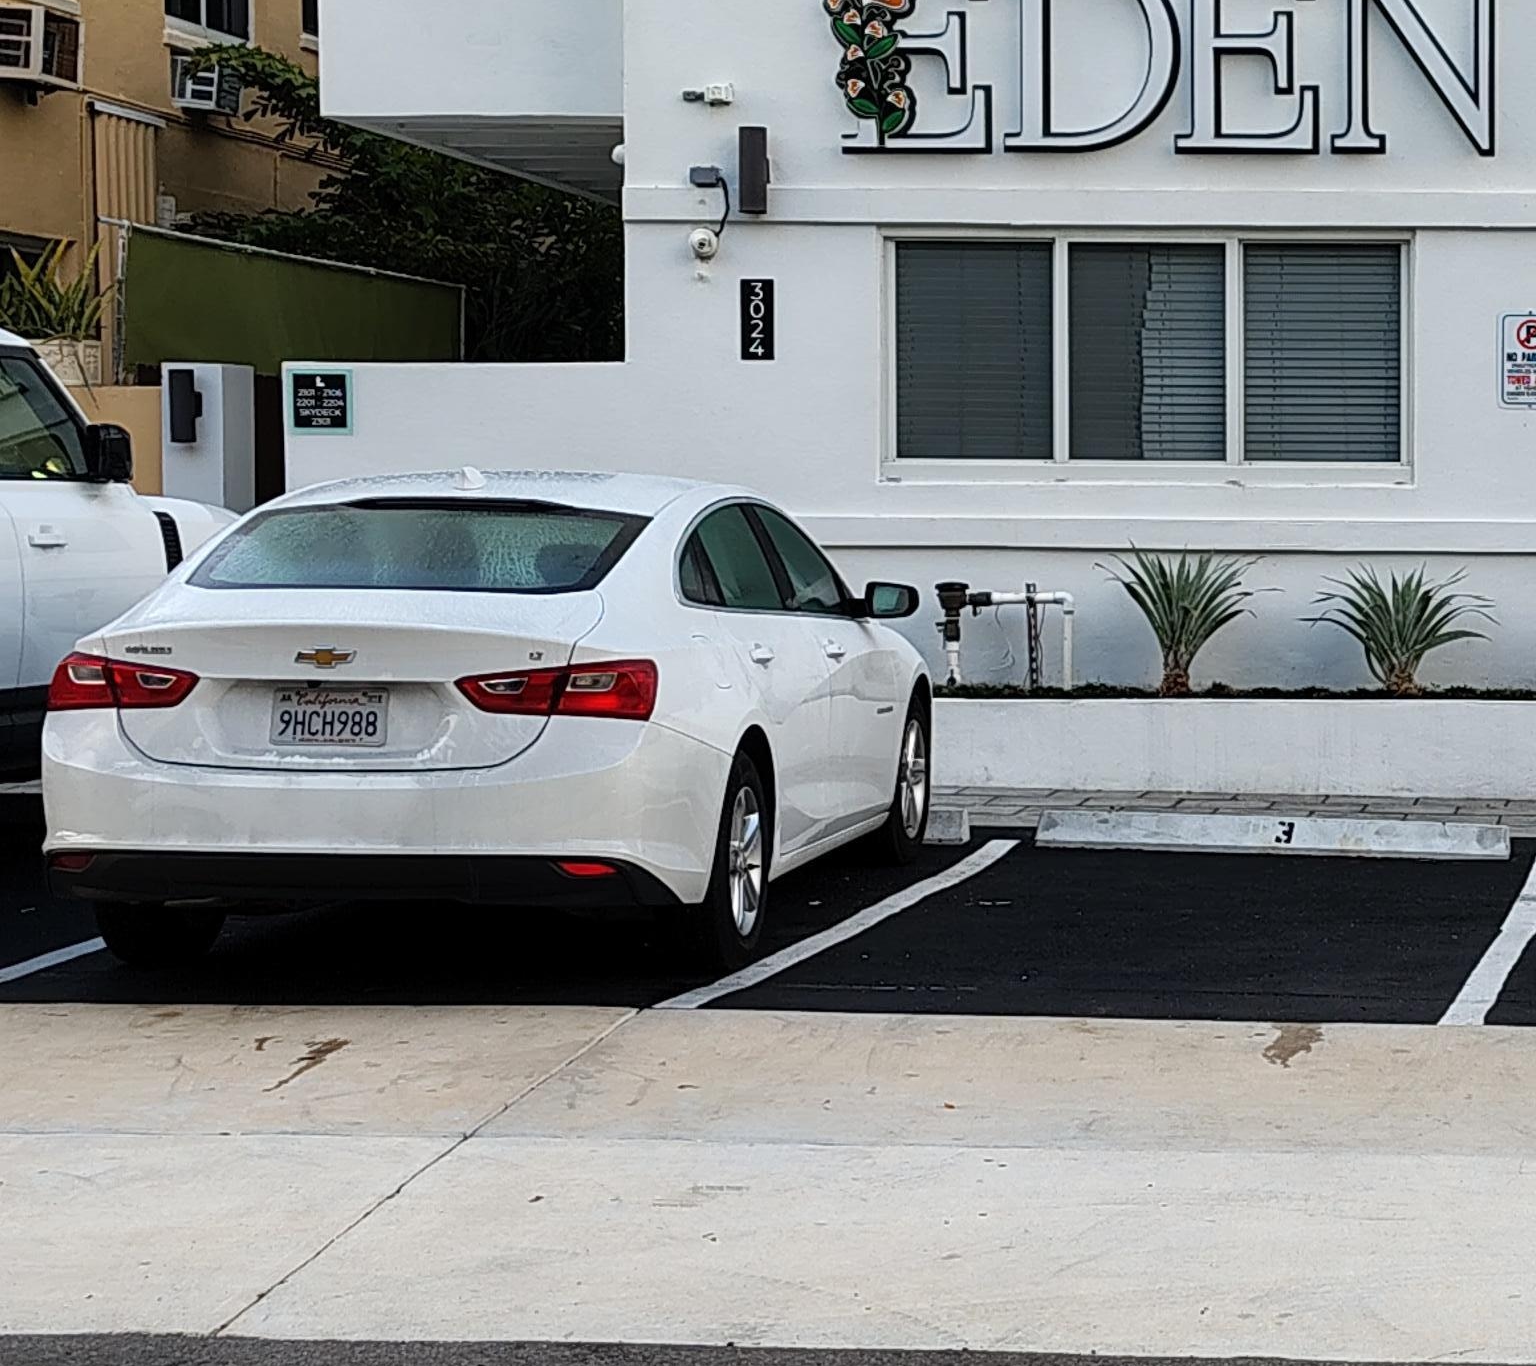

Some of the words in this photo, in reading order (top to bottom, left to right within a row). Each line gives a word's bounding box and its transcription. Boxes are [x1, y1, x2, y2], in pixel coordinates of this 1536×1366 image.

[749, 282, 765, 357] 3024
[1506, 352, 1517, 362] NO
[1507, 375, 1531, 385] TOWED
[296, 691, 366, 709] California
[278, 710, 378, 737] 9HCH988
[1275, 821, 1295, 844] 3
